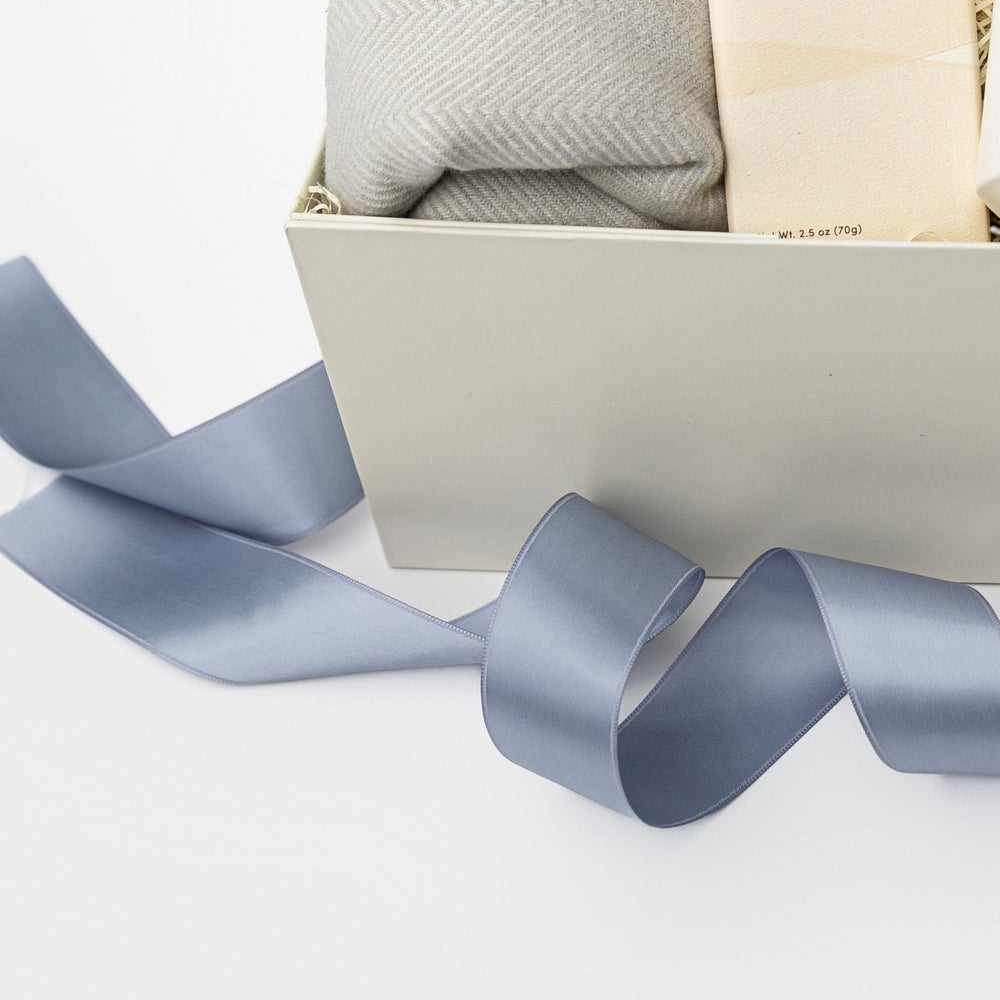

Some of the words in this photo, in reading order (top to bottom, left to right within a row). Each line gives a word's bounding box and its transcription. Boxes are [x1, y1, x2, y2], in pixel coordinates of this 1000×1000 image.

[778, 231, 796, 239] Wt.
[799, 229, 815, 238] 2.5
[834, 224, 862, 236] (70g)
